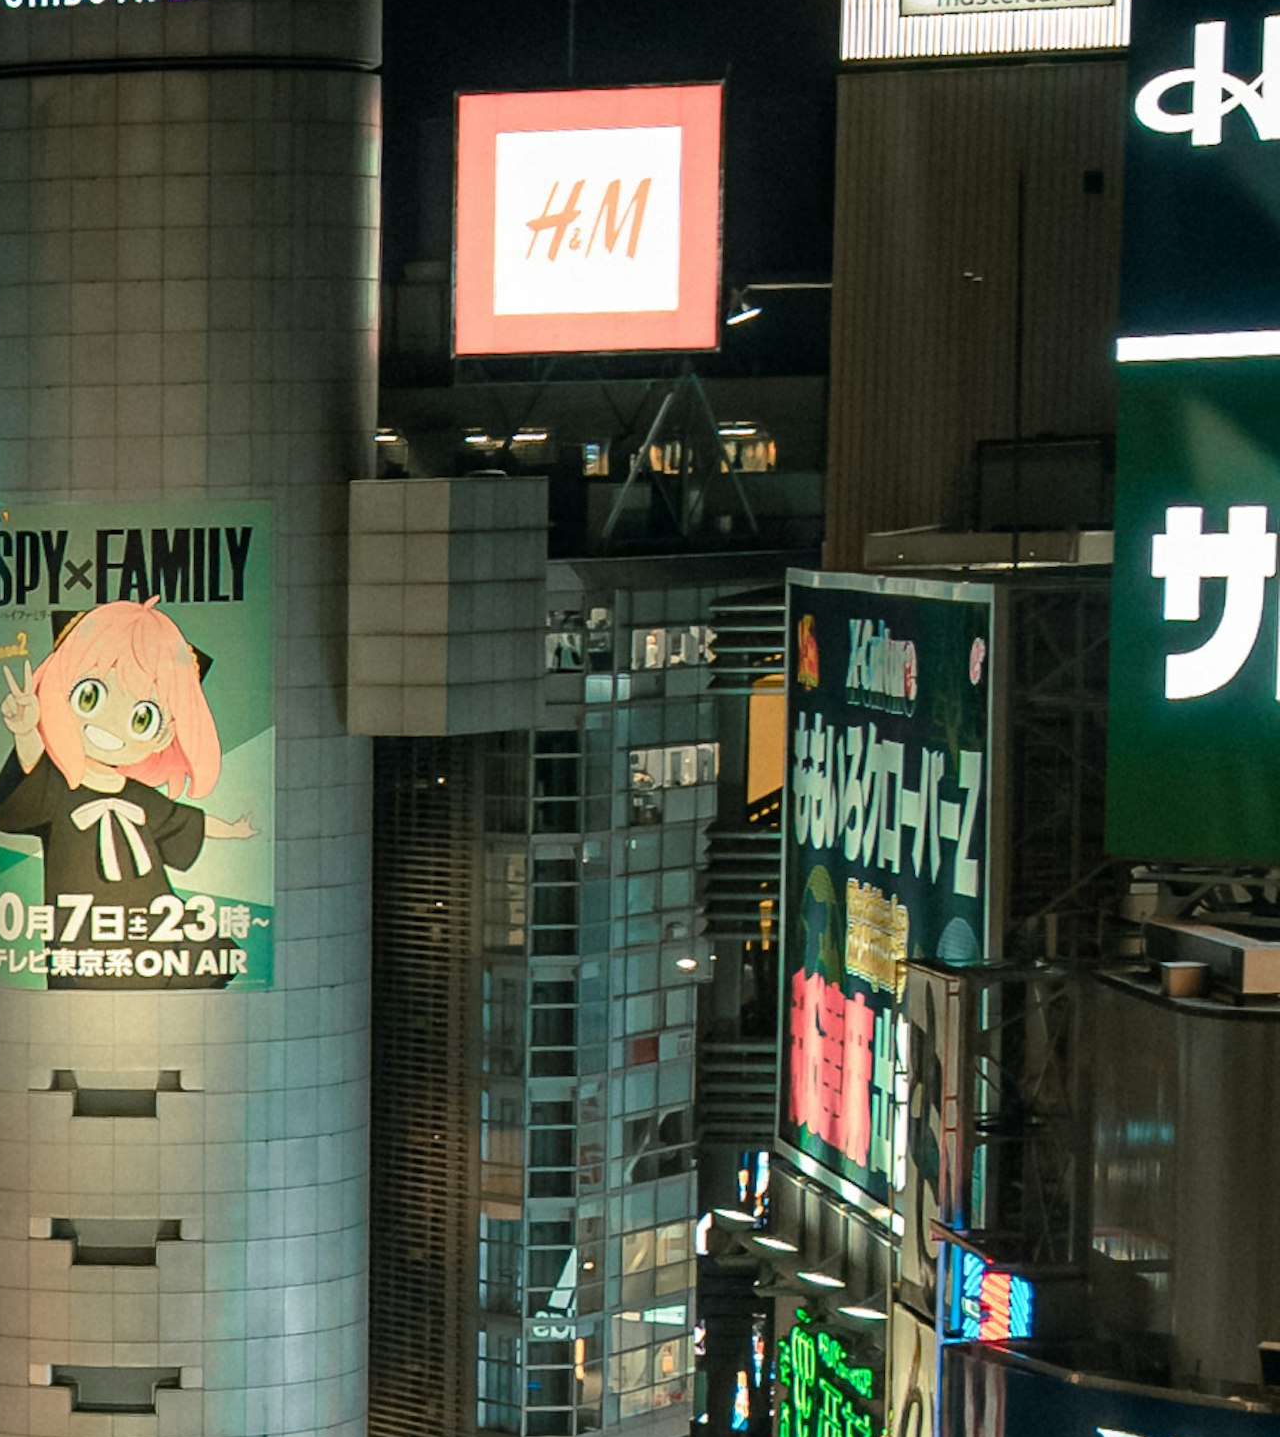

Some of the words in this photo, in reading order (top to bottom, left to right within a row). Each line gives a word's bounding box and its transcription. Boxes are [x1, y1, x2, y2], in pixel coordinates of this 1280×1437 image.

[526, 178, 652, 262] H&M
[792, 711, 983, 898] ももいろクローバーZ
[135, 950, 190, 976] ON
[194, 949, 248, 974] AIR
